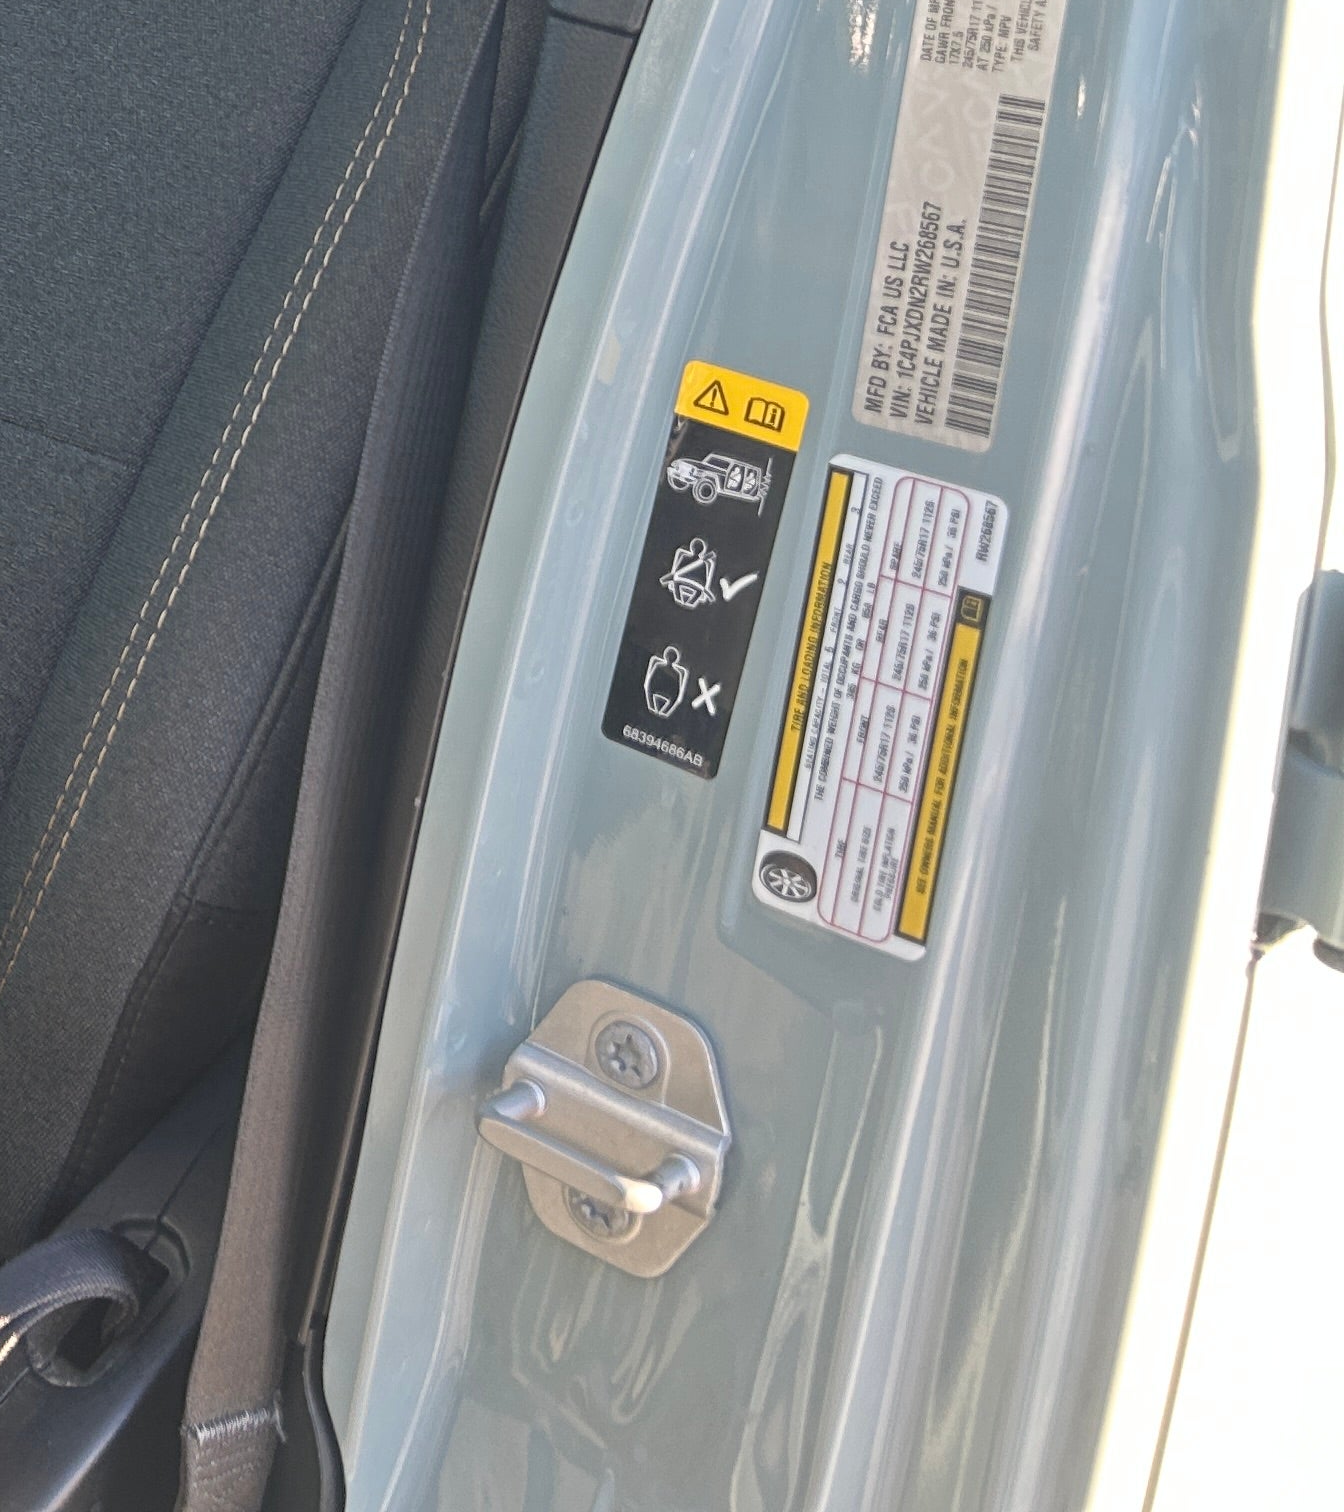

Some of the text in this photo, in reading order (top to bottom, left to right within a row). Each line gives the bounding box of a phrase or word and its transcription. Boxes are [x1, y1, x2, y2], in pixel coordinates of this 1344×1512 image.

[925, 17, 938, 31] OF
[961, 14, 980, 69] 245/75R17
[982, 12, 997, 33] kPa
[997, 14, 1012, 38] MPV
[1027, 10, 1045, 52] SAFETY
[920, 33, 935, 62] DATE
[934, 31, 950, 64] GAWR
[975, 56, 989, 71] AT
[979, 35, 993, 53] 250
[1010, 37, 1026, 62] THIS
[864, 240, 909, 413] MFD BY: FCA US LLC
[889, 201, 941, 419] VIN: 1C4PJXDN2RW268567
[914, 218, 966, 425] VEHICLE MADE IN: U.S.A.
[975, 500, 997, 562] RW268567
[790, 561, 832, 733] TIRE AND LOADING INFORMATION
[814, 476, 883, 801] THE COMBINED WEIGHT OF OCCUPANTS AND CARGO SHOULD NEVER EXCEED
[622, 724, 704, 768] 68394686AB
